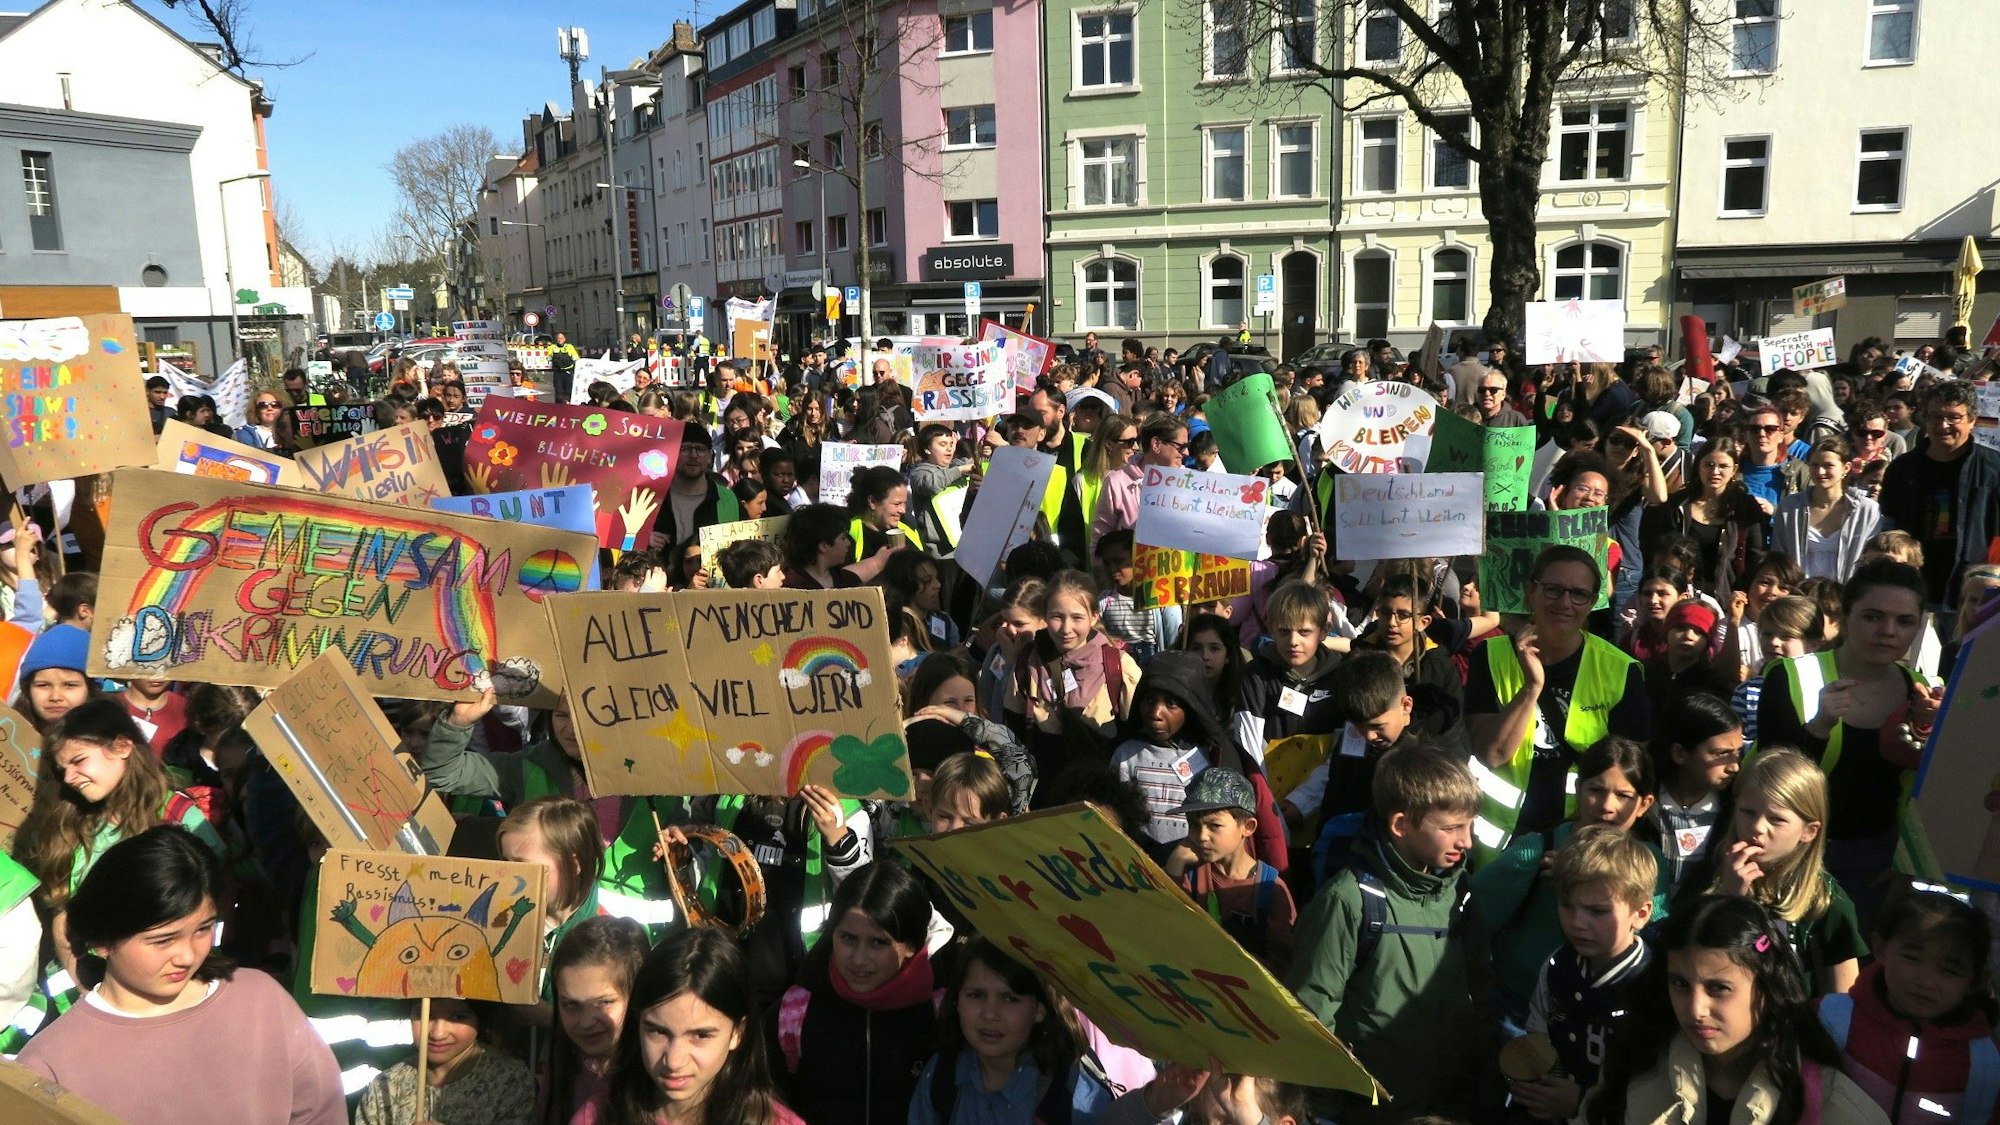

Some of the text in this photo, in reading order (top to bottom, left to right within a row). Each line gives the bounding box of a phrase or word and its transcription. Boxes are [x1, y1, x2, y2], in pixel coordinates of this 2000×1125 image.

[857, 262, 888, 274] aolute.
[934, 254, 1007, 270] absolute.
[1764, 333, 1809, 348] Seperate
[1780, 338, 1834, 352] TRASH not
[922, 349, 953, 370] WIR
[964, 345, 998, 369] SIND
[1771, 346, 1835, 371] PEOPLE
[0, 364, 88, 391] MEINSAM
[942, 370, 987, 388] GEGE
[924, 380, 1007, 410] RASSISUS
[1337, 383, 1411, 410] WIR SIND
[496, 409, 666, 440] VIELFALT SOLL
[1363, 405, 1397, 418] UND
[537, 440, 617, 468] BLÜHEN
[833, 447, 896, 462] WIR SIND
[1147, 468, 1239, 497] Deutschland
[1338, 477, 1455, 503] Deutschland
[1172, 496, 1201, 512] bunt
[1559, 510, 1608, 539] PLATZ
[138, 501, 512, 597] GEMEINSAM
[237, 570, 411, 624] GEGEN
[584, 600, 873, 663] ALLE MENSCHEN SIND
[281, 667, 338, 719] GLEICHE
[582, 669, 863, 727] GLEICH VIEL WERT
[306, 698, 359, 742] RECHTE
[340, 854, 490, 890] Fresst mehr
